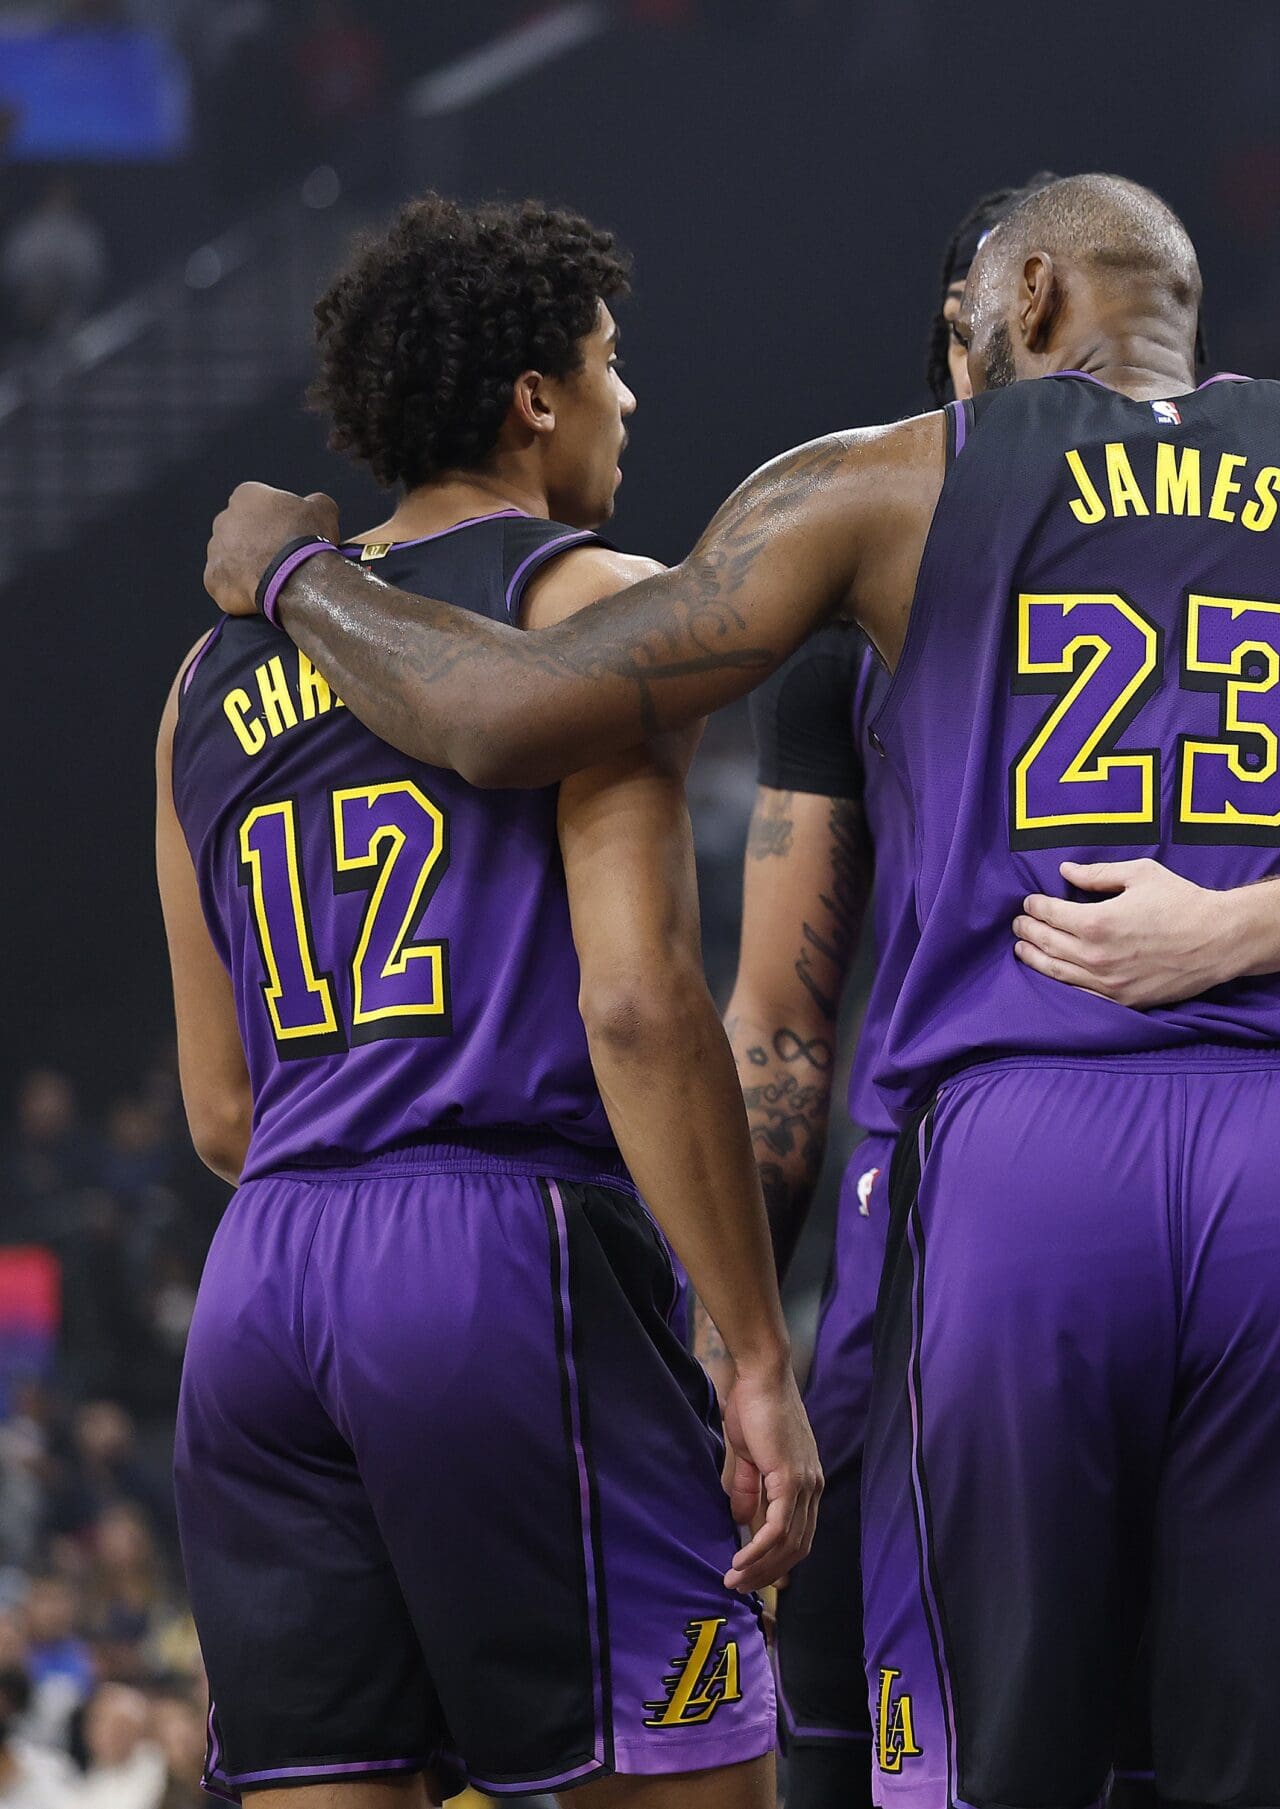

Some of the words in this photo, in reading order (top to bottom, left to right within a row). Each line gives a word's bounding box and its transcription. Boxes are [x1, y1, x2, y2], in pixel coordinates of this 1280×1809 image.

[223, 649, 346, 756] CHR
[239, 780, 444, 1040] 12
[644, 1618, 742, 1725] LA
[874, 1668, 920, 1771] LA
